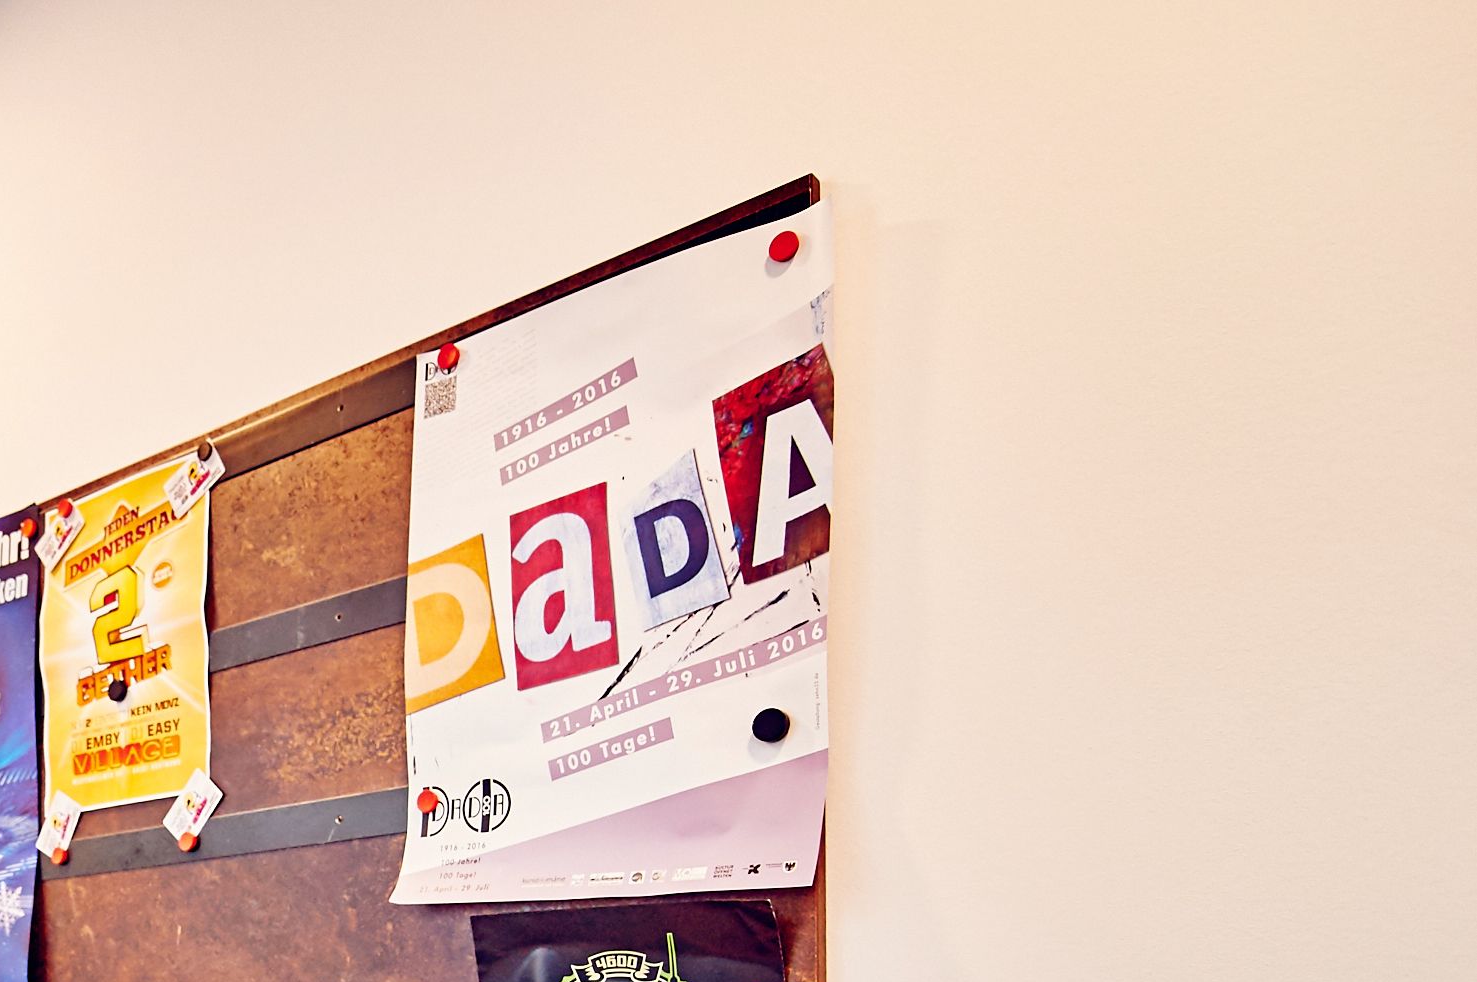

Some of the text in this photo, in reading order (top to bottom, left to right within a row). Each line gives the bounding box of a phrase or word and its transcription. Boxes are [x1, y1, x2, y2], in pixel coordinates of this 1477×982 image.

[501, 412, 547, 446] 1916
[571, 370, 622, 410] 2016
[505, 452, 540, 481] 100
[548, 416, 612, 460] Jahre!
[103, 506, 141, 541] JEDEN
[89, 564, 150, 665] 2
[549, 717, 581, 739] 21.
[590, 688, 639, 723] April
[666, 671, 702, 694] 29.
[714, 650, 756, 678] Juli
[767, 621, 824, 660] 2016
[73, 734, 181, 776] VILLAGE
[86, 731, 120, 750] EMBY
[147, 718, 181, 737] EASY
[555, 726, 656, 775] 100 Tage!
[596, 955, 638, 970] 4600
